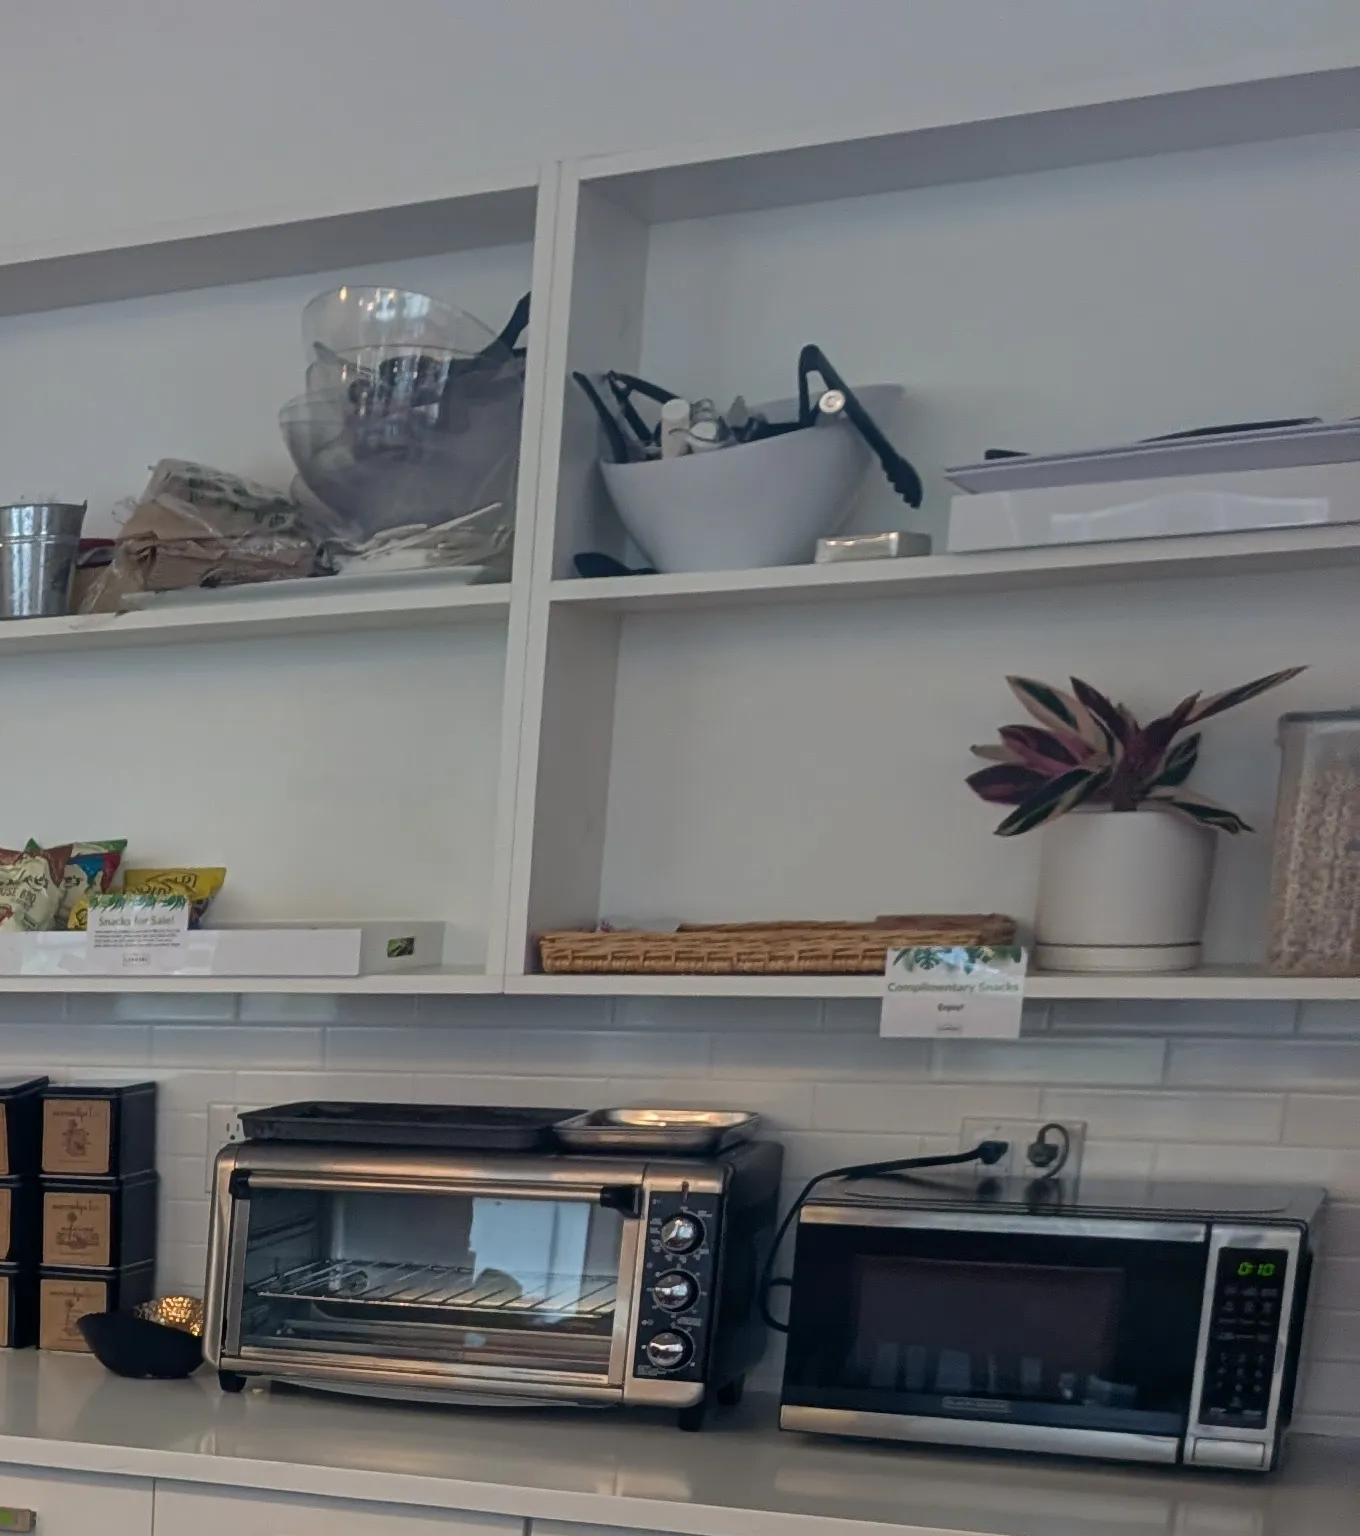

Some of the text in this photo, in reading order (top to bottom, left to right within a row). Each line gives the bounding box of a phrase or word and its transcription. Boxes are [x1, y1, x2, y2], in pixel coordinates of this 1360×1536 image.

[99, 916, 131, 926] Snacks
[134, 914, 148, 925] for
[887, 981, 1019, 994] Complimentary Snacks
